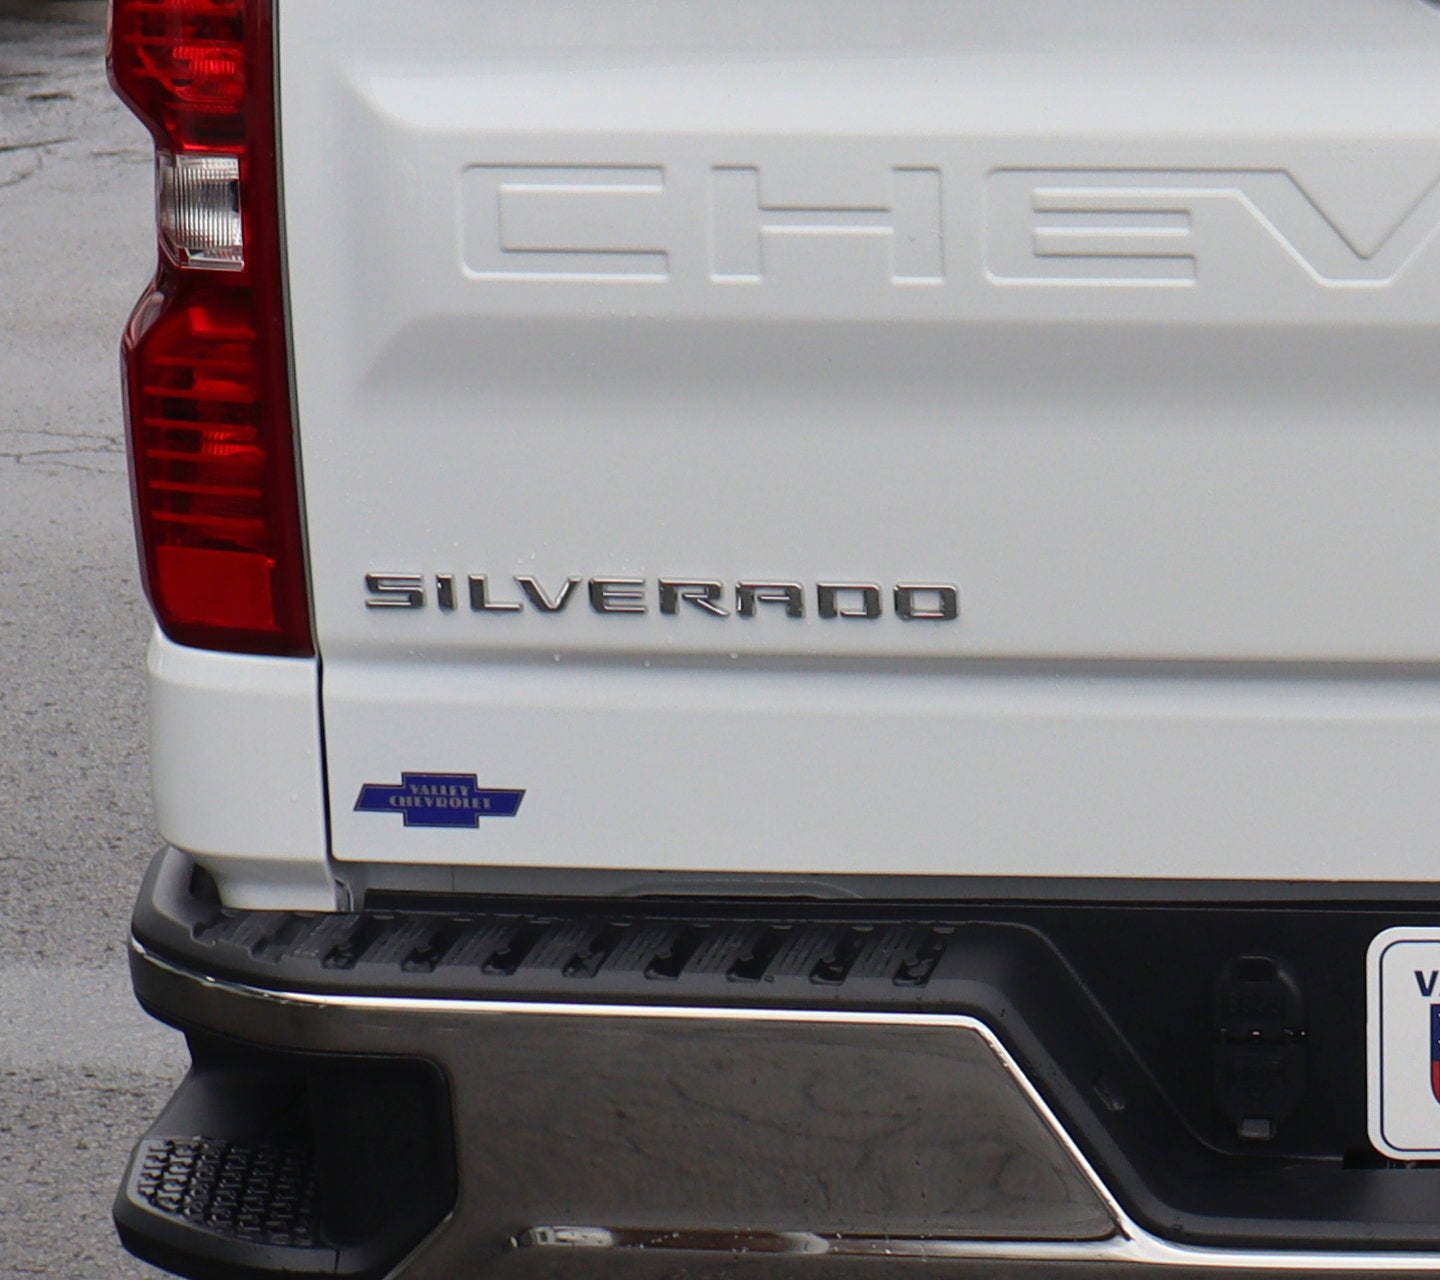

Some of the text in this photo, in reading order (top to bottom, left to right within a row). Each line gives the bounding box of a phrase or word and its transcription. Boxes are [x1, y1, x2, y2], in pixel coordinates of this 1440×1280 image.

[364, 572, 959, 620] SILVERADO
[410, 784, 470, 797] VALLEY
[389, 796, 491, 809] CHEVROLET
